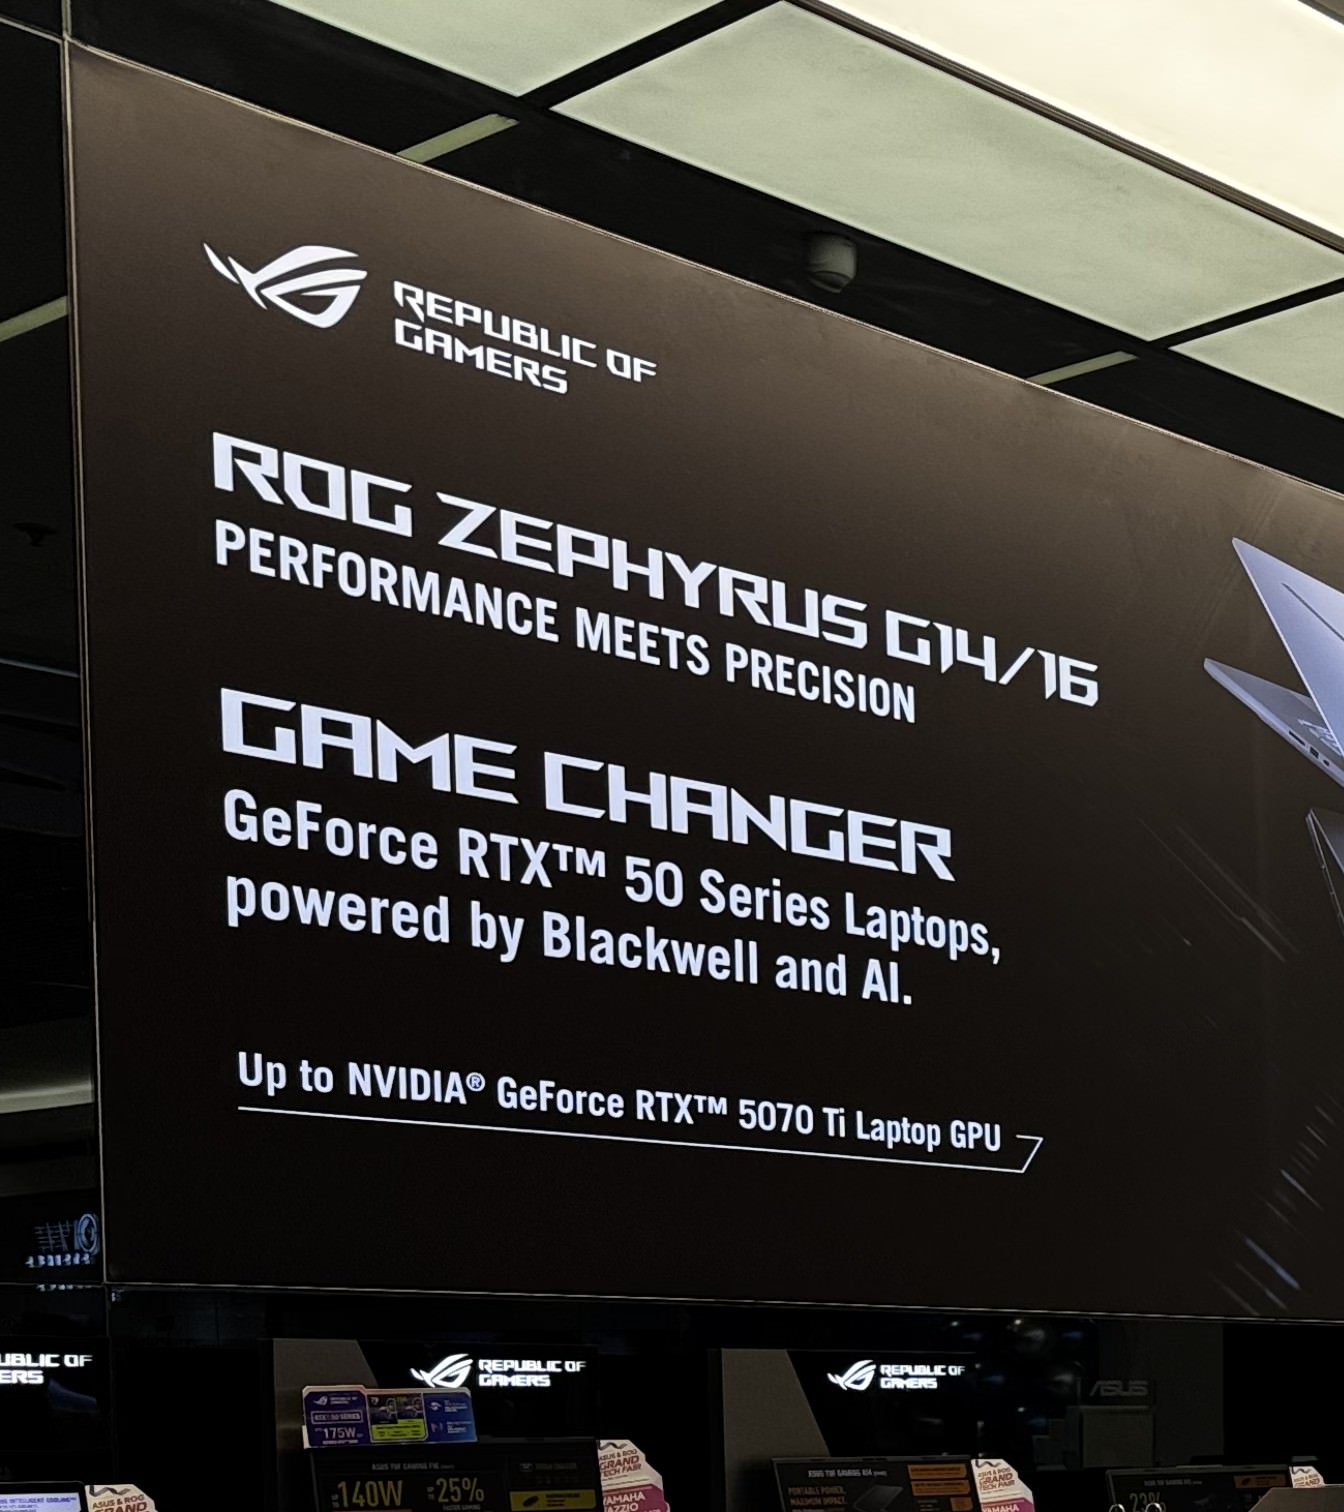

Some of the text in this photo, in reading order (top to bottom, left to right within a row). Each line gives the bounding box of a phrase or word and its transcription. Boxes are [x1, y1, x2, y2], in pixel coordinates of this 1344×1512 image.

[394, 280, 658, 385] REPUBLIC OF
[395, 318, 569, 395] GAMERS
[212, 431, 1099, 707] ROG ZEPHYRUS G14/16
[215, 519, 916, 724] PERFORMANCE MEETS PRECISION
[220, 687, 956, 882] GAME CHANGER
[223, 788, 440, 872] GeForce
[625, 856, 685, 908] 50
[700, 868, 830, 933] Series
[844, 893, 1002, 964] Laptops,
[225, 875, 914, 1006] powered by Blackwell and AI.
[238, 1051, 287, 1095] Up
[300, 1058, 334, 1094] to
[497, 1076, 625, 1119] GeForce
[738, 1099, 815, 1136] 5070
[824, 1106, 846, 1139] Ti
[855, 1110, 941, 1153] Laptop
[950, 1120, 1002, 1153] GPU
[64, 1354, 93, 1367] OF
[478, 1359, 586, 1373] REPUBLIC OF
[478, 1374, 551, 1387] GAMERS
[880, 1363, 966, 1377] REPUBLIC OF
[880, 1376, 939, 1390] GAMERS
[1090, 1380, 1148, 1396] ASUS
[92, 1499, 116, 1509] ASUS
[124, 1494, 145, 1504] ROG
[337, 1477, 484, 1508] 140W 25%
